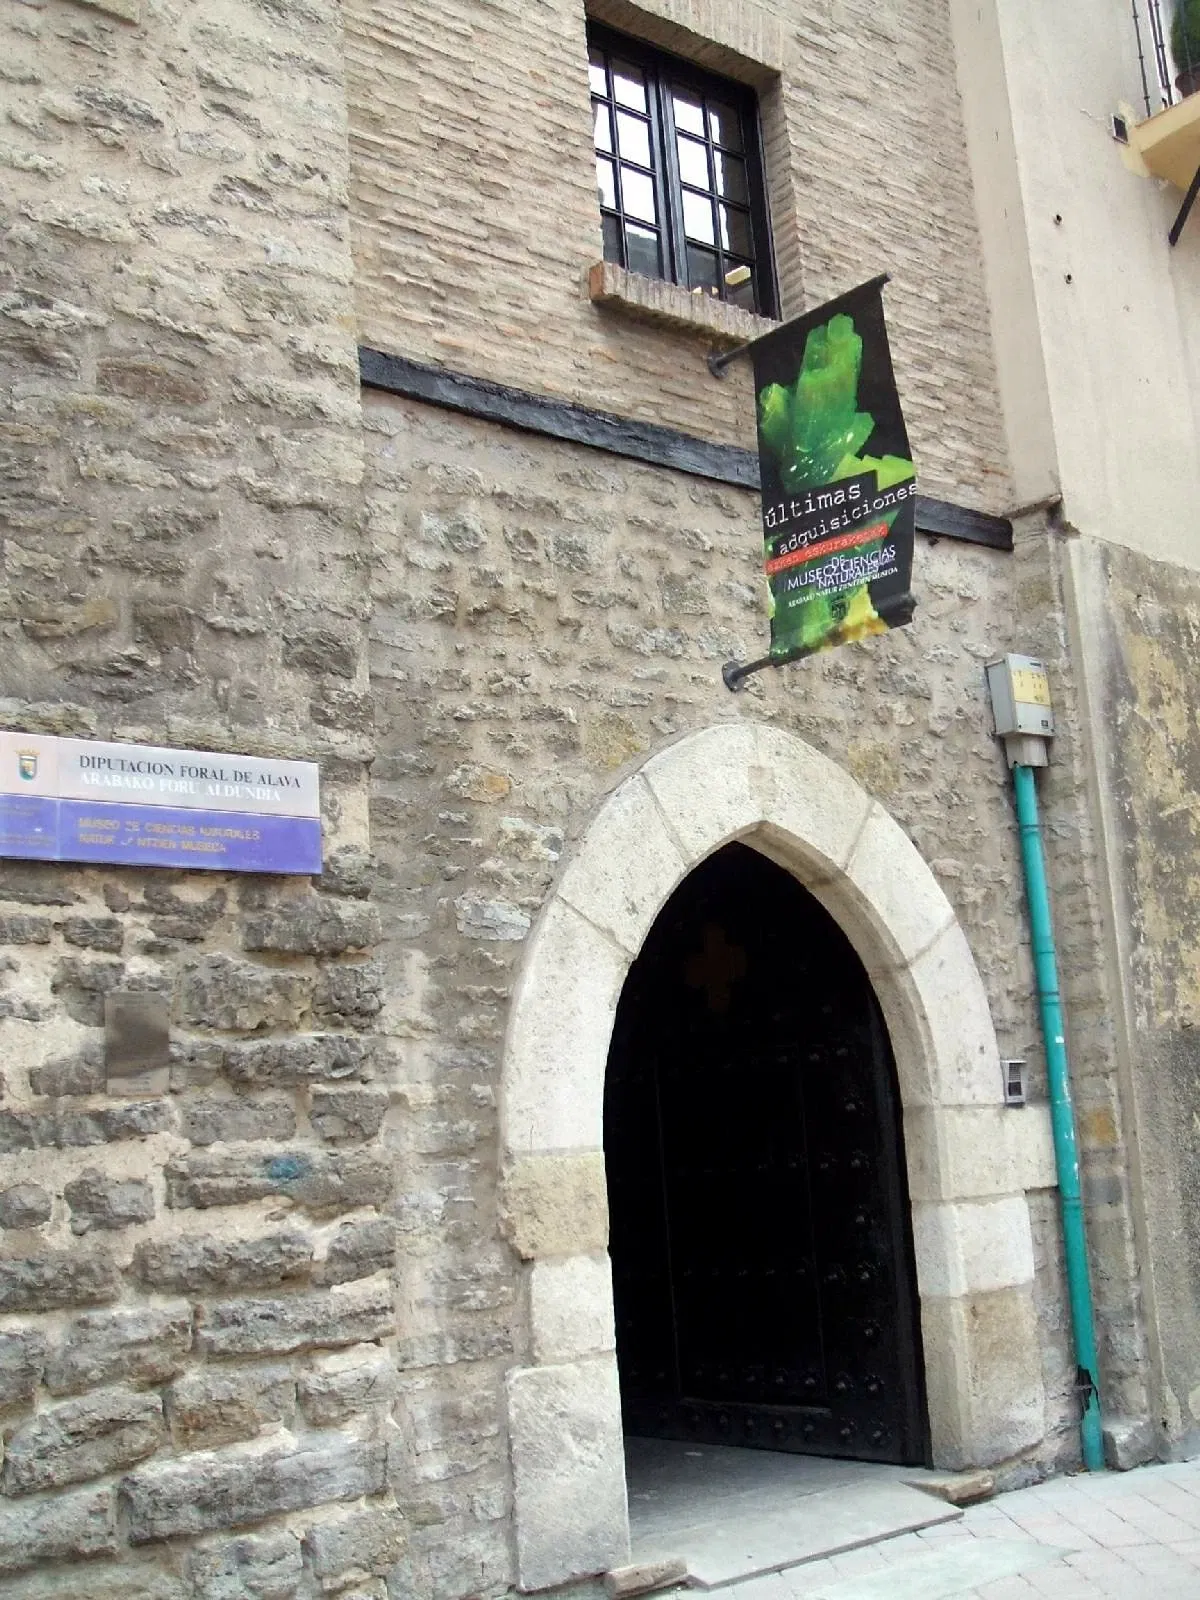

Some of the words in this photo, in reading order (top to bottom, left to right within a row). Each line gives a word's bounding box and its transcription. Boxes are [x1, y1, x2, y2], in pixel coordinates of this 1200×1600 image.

[765, 484, 861, 528] últimas
[779, 482, 917, 555] adquisiciones
[787, 564, 835, 590] MUSEO
[841, 545, 896, 571] CIENCIAS
[818, 564, 880, 589] NATURALES
[80, 755, 173, 776] DIPUTACION
[180, 765, 227, 781] FORAL
[234, 769, 253, 783] DE
[258, 773, 301, 788] ALAVA
[80, 771, 155, 790] ARABAKO
[206, 784, 281, 801] ALDUNDIA
